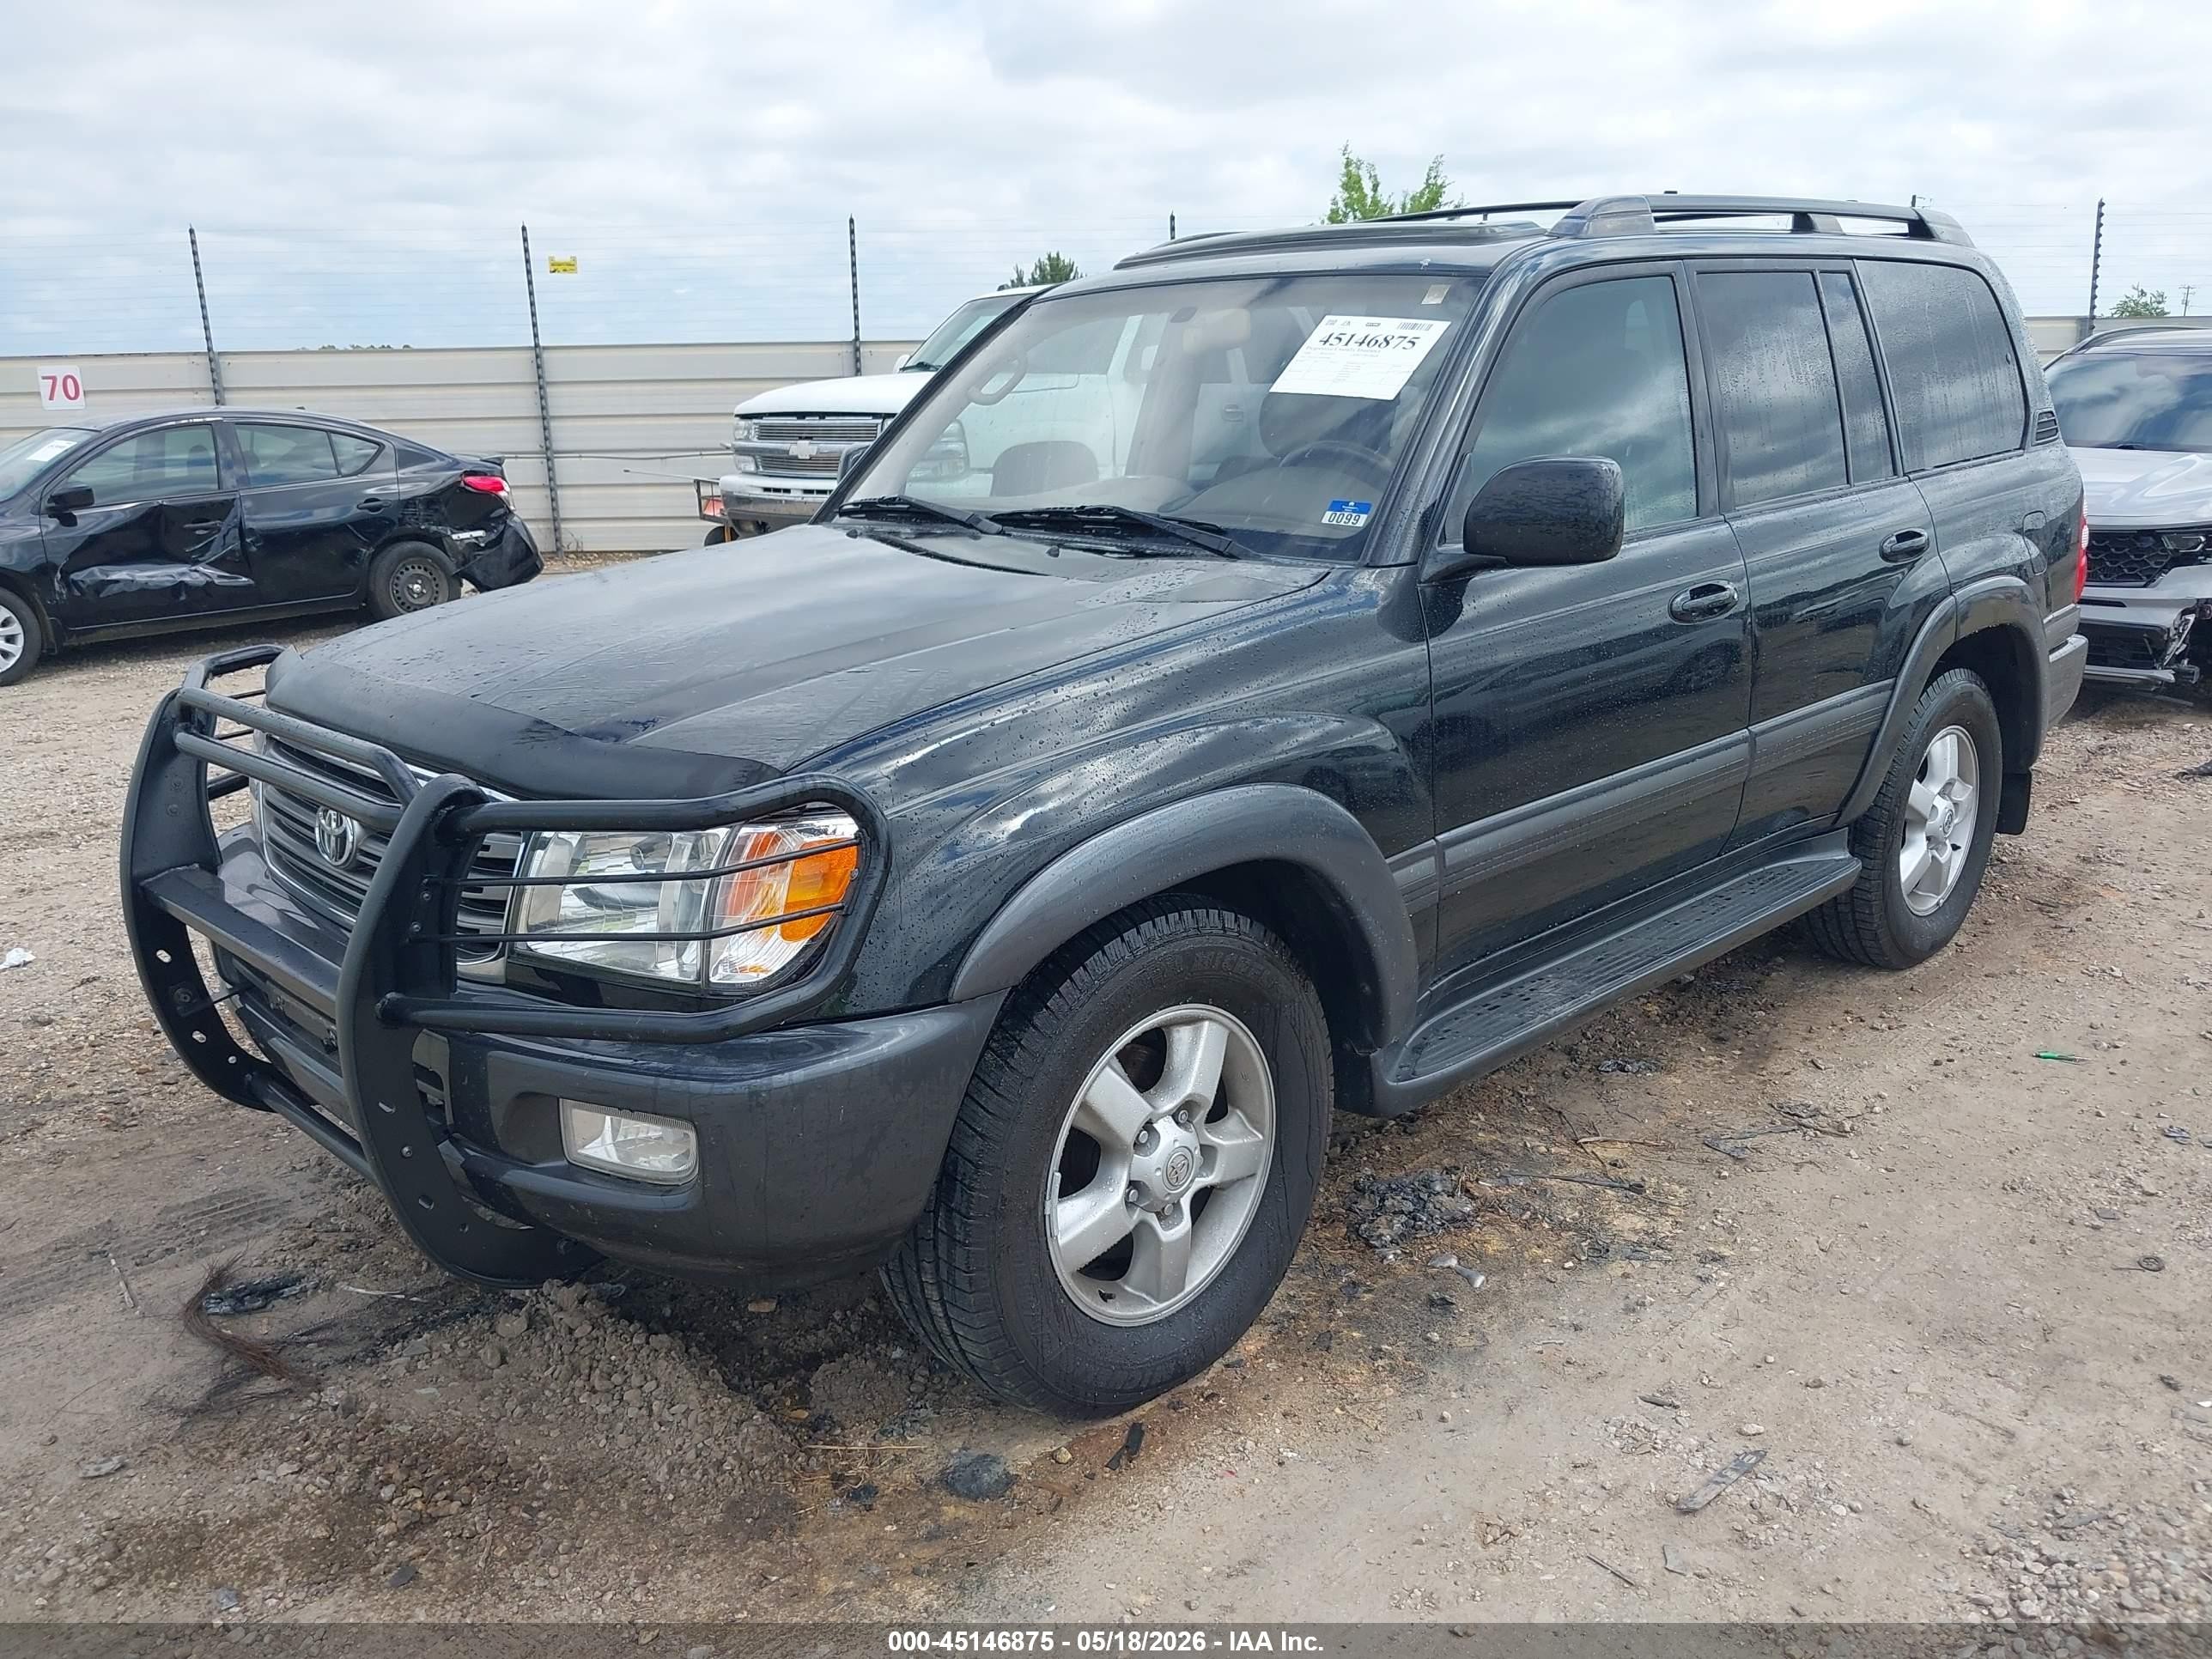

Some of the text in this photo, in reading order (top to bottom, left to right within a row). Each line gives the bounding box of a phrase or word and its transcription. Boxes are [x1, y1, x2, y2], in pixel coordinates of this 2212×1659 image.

[1319, 332, 1421, 349] 45146875
[40, 374, 81, 401] 70
[1328, 513, 1361, 526] 0099
